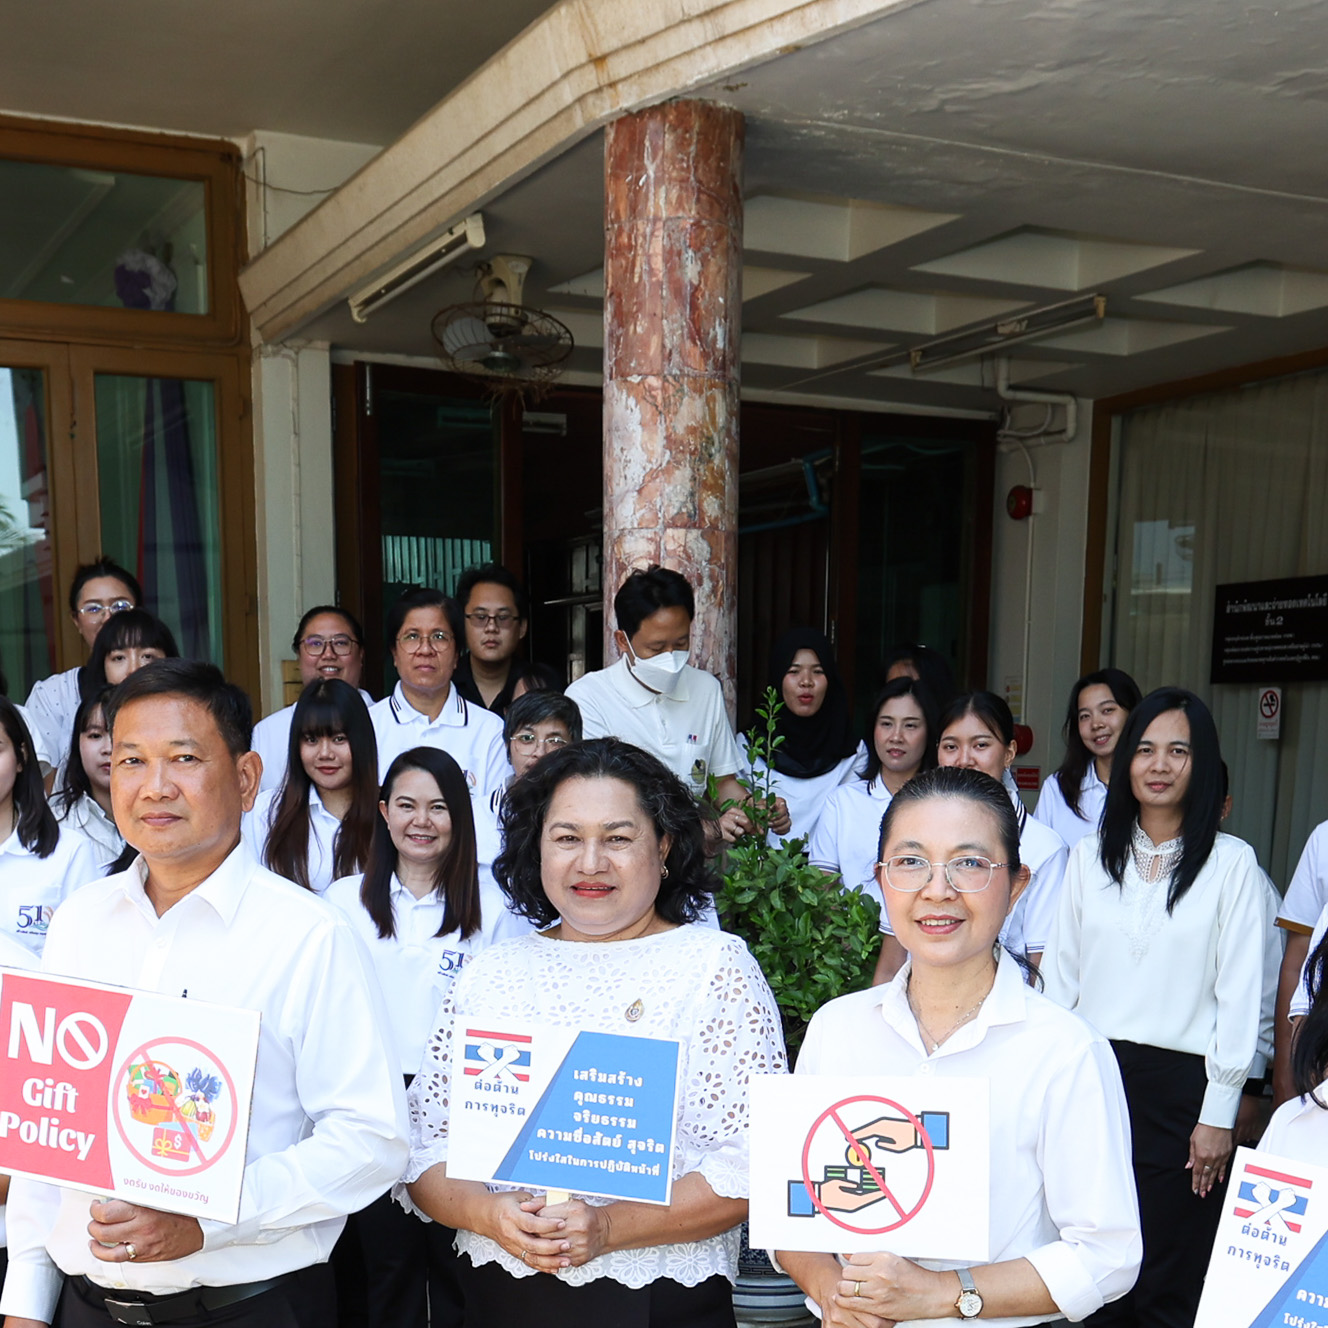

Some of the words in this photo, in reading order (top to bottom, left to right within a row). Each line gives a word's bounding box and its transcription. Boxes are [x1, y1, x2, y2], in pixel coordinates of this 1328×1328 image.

[1276, 616, 1284, 625] 2
[16, 905, 43, 928] 51
[439, 949, 464, 970] 51
[7, 1001, 109, 1070] NO
[473, 1079, 519, 1095] ต่อต้าน
[573, 1068, 644, 1088] เสริมสร้าง
[22, 1077, 79, 1114] Gift
[573, 1090, 634, 1108] คุณธรรม
[464, 1100, 526, 1117] การทุจริต
[573, 1109, 637, 1130] จริยธรรม
[627, 1138, 665, 1155] สุจริต
[528, 1149, 661, 1177] โปร่งใสในการปฏิบัติหน้าที่
[123, 1177, 147, 1189] งดรับ
[149, 1182, 209, 1204] งดให้ของขวัญ
[1241, 1223, 1288, 1247] ต่อต้าน
[1226, 1245, 1291, 1273] การทุจริต
